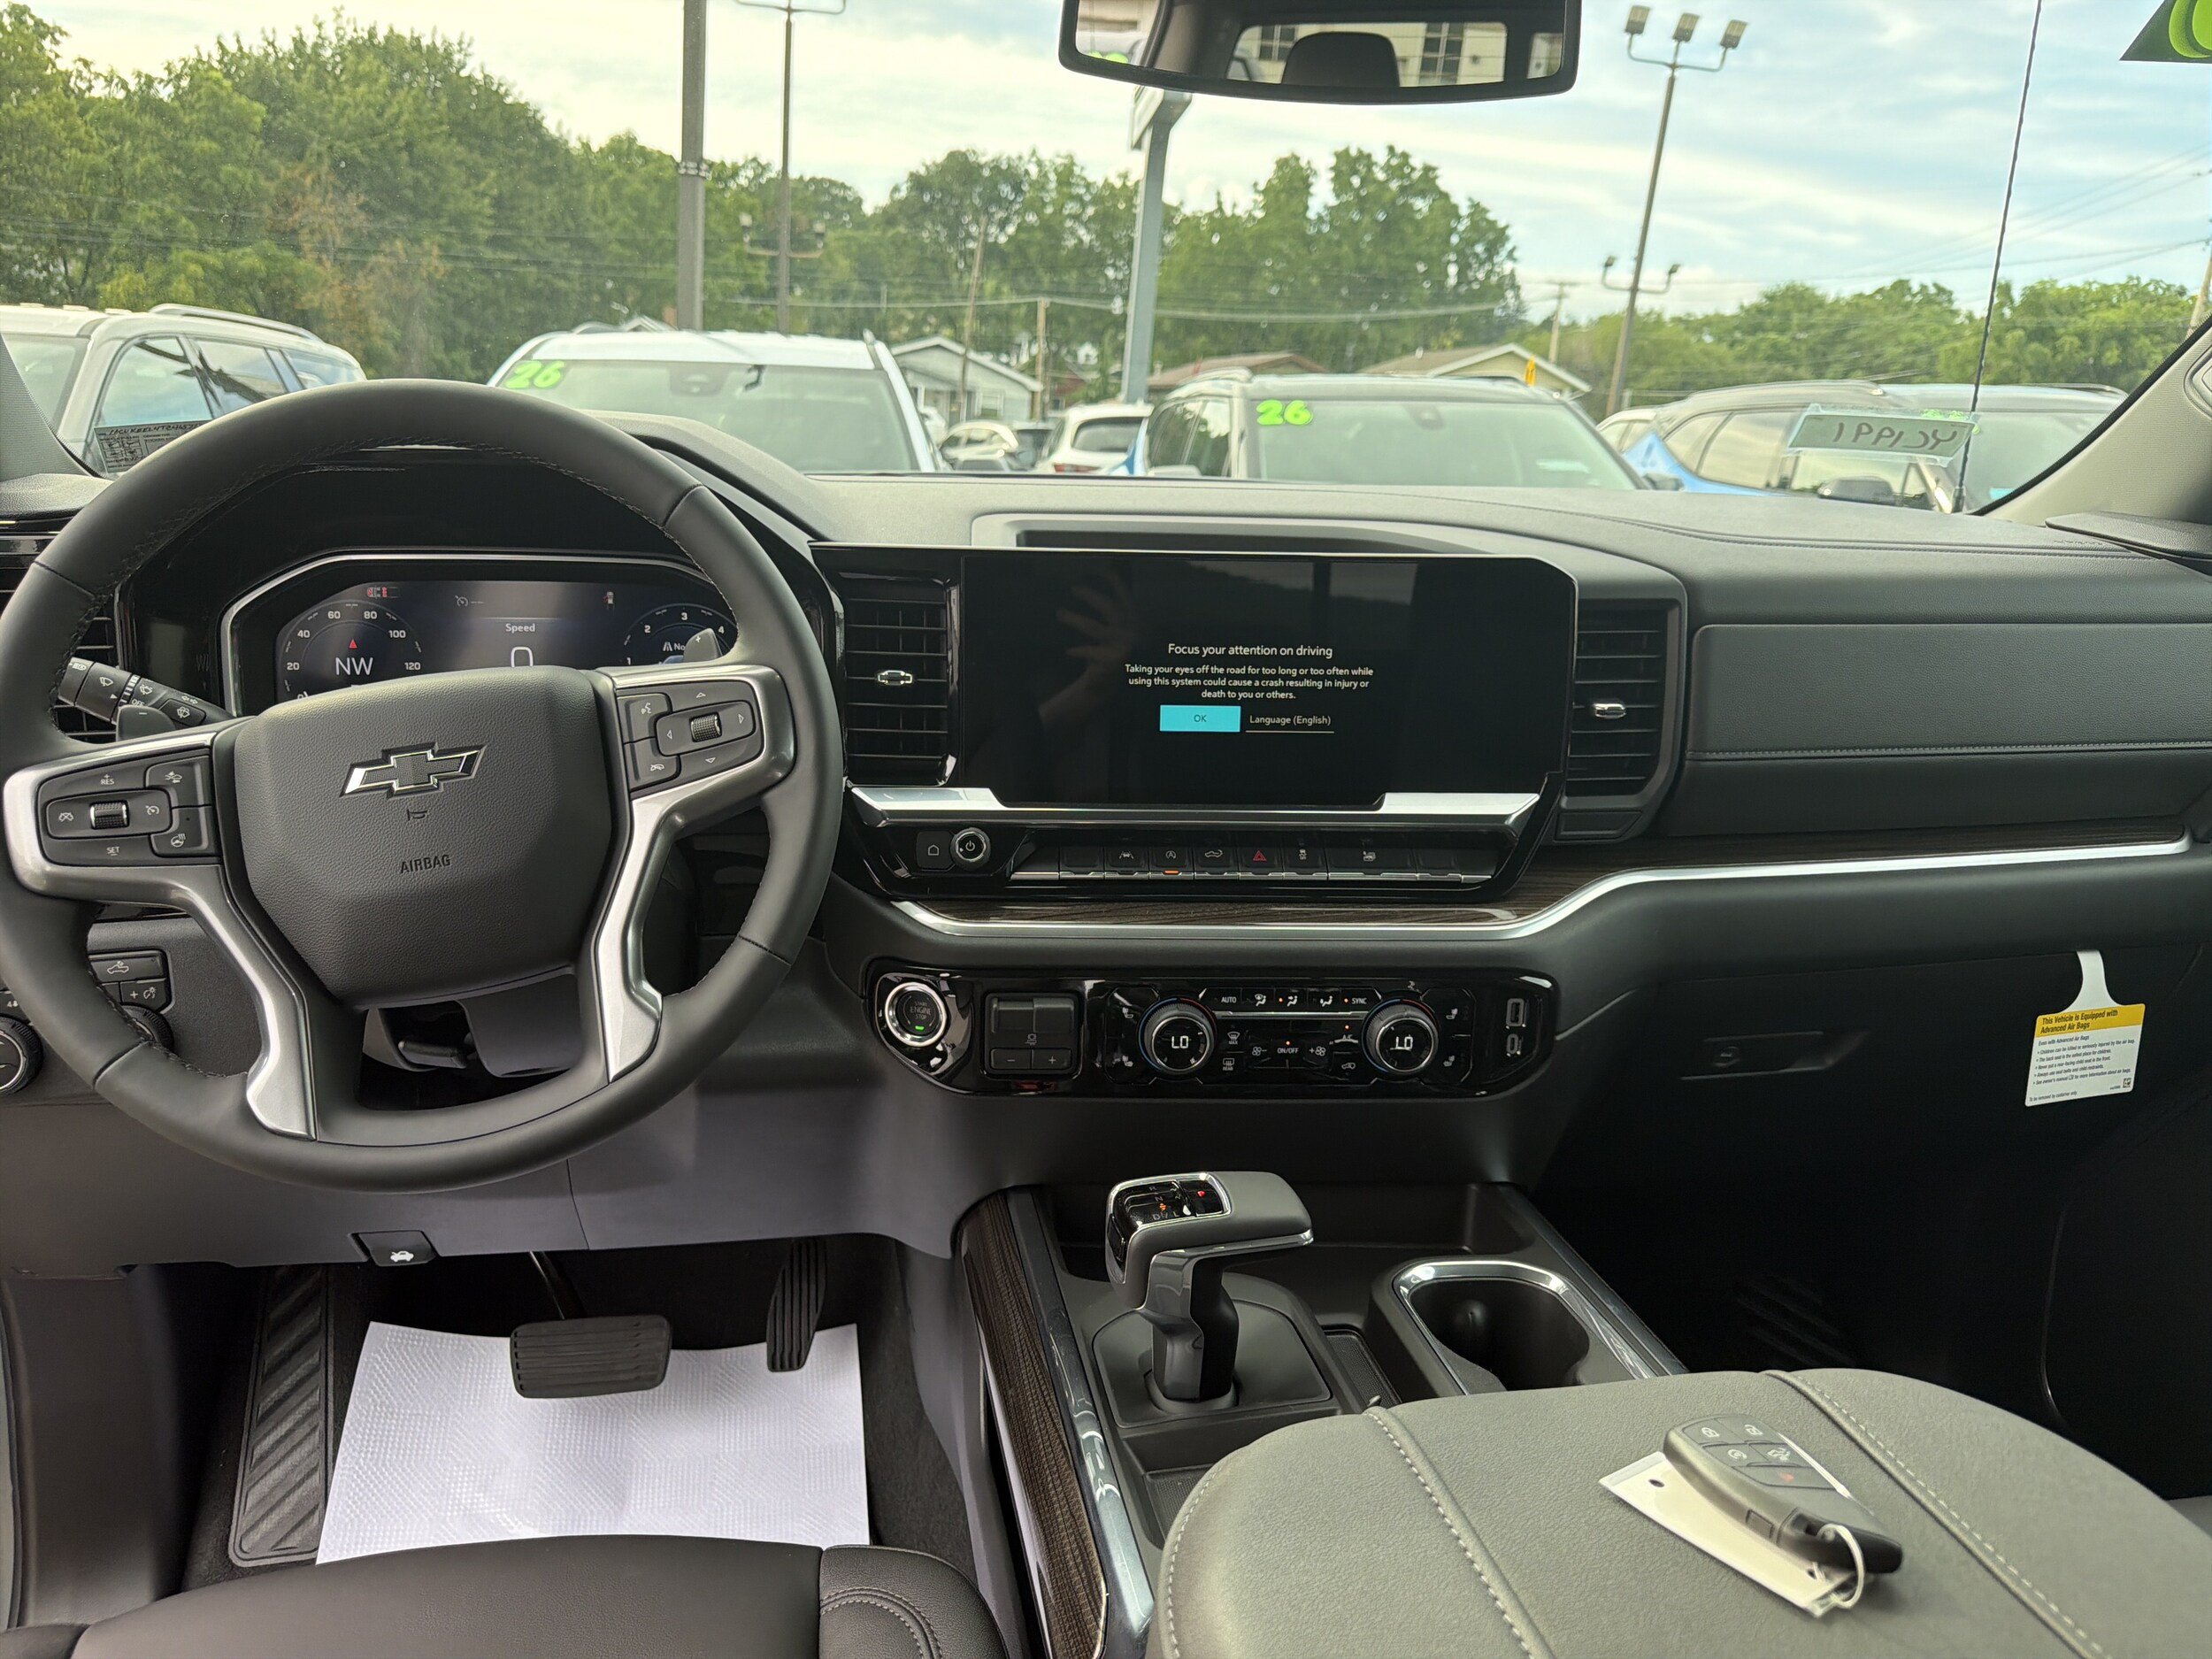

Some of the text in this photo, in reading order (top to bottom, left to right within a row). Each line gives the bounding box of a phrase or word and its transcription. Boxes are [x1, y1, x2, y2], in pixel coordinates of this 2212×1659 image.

[504, 359, 566, 388] 26
[1256, 398, 1313, 426] 26
[327, 611, 341, 619] 60
[364, 611, 377, 619] 80
[505, 623, 535, 634] Speed
[1168, 643, 1333, 659] Focus your attention on driving
[287, 662, 300, 671] 20
[335, 657, 373, 676] NW
[404, 662, 421, 671] 120
[1125, 664, 1152, 675] Taking
[1155, 666, 1173, 675] your
[1175, 666, 1194, 675] eyes
[1195, 664, 1210, 673] off
[1210, 664, 1225, 673] the
[1225, 665, 1247, 674] road
[1248, 665, 1260, 674] for
[1278, 665, 1297, 677] long
[1326, 666, 1349, 675] often
[1351, 667, 1374, 676] while
[1128, 677, 1152, 687] using
[1154, 677, 1170, 686] this
[1171, 678, 1202, 687] system
[1202, 677, 1226, 686] could
[1261, 678, 1284, 687] crash
[1286, 678, 1323, 689] resulting
[1325, 679, 1333, 687] in
[1334, 679, 1358, 689] injury
[1202, 689, 1225, 698] death
[1238, 691, 1253, 700] you
[1266, 690, 1296, 699] others.
[1194, 714, 1207, 723] OK
[1249, 715, 1332, 726] Language (English)
[401, 854, 451, 874] AIRBAG
[910, 1006, 931, 1016] ENGINE
[2055, 1015, 2073, 1024] Vehicle
[2080, 1011, 2106, 1021] Equipped
[2040, 1025, 2066, 1034] Advanced
[2077, 1021, 2090, 1030] Bags
